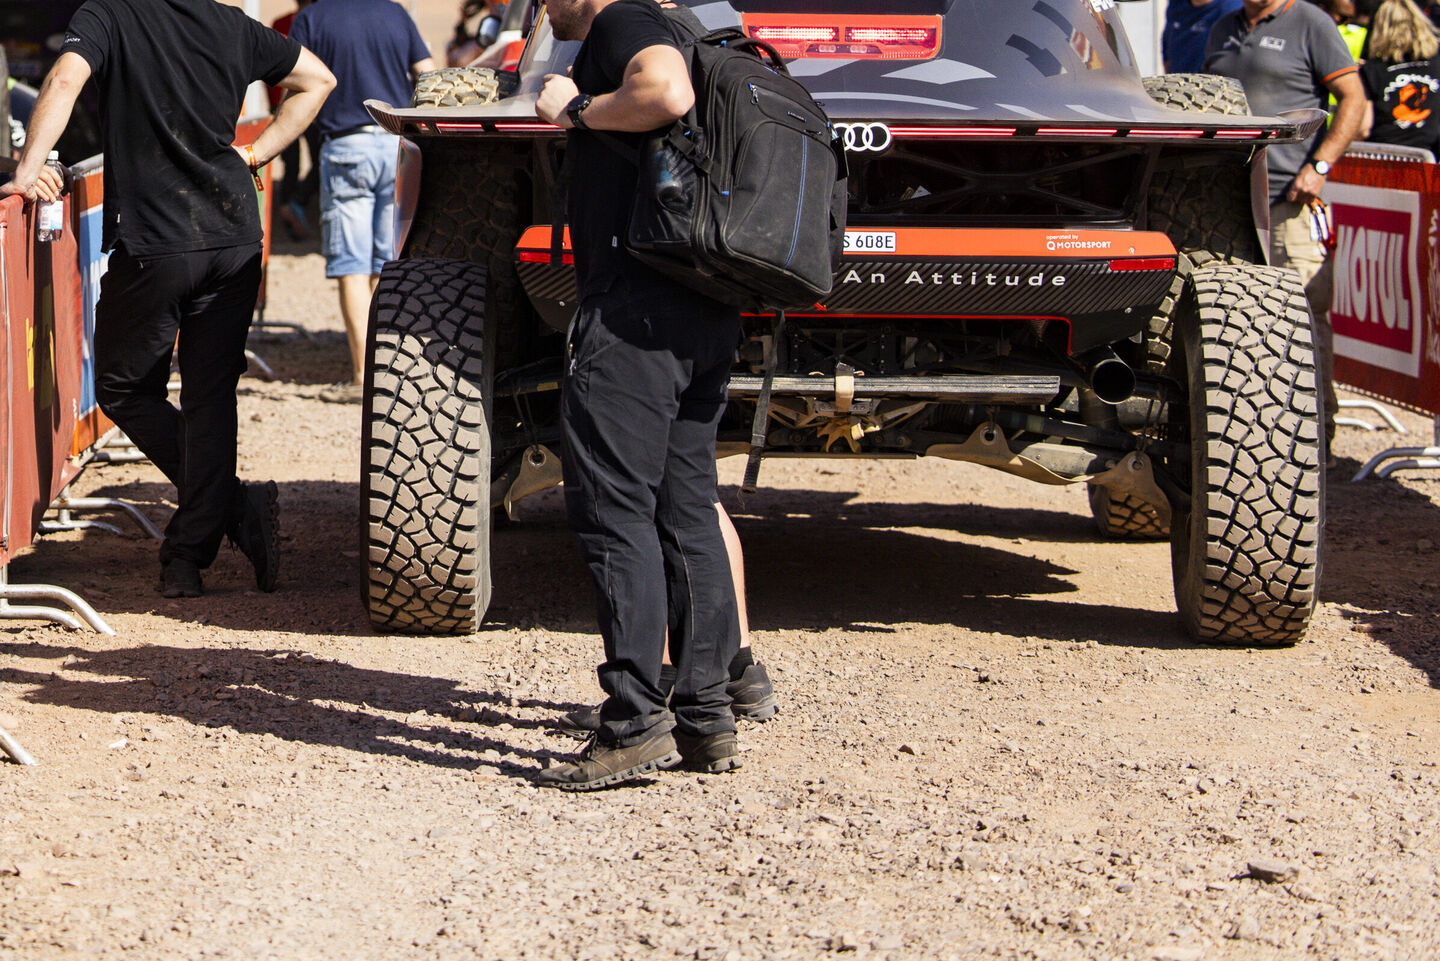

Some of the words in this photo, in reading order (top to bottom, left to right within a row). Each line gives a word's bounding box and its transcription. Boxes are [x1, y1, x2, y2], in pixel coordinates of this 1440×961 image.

[855, 234, 894, 249] 608E
[1057, 241, 1112, 249] MOTORSPORT
[842, 269, 886, 284] An
[904, 270, 1067, 287] Attitude
[1331, 223, 1410, 331] MOTUL
